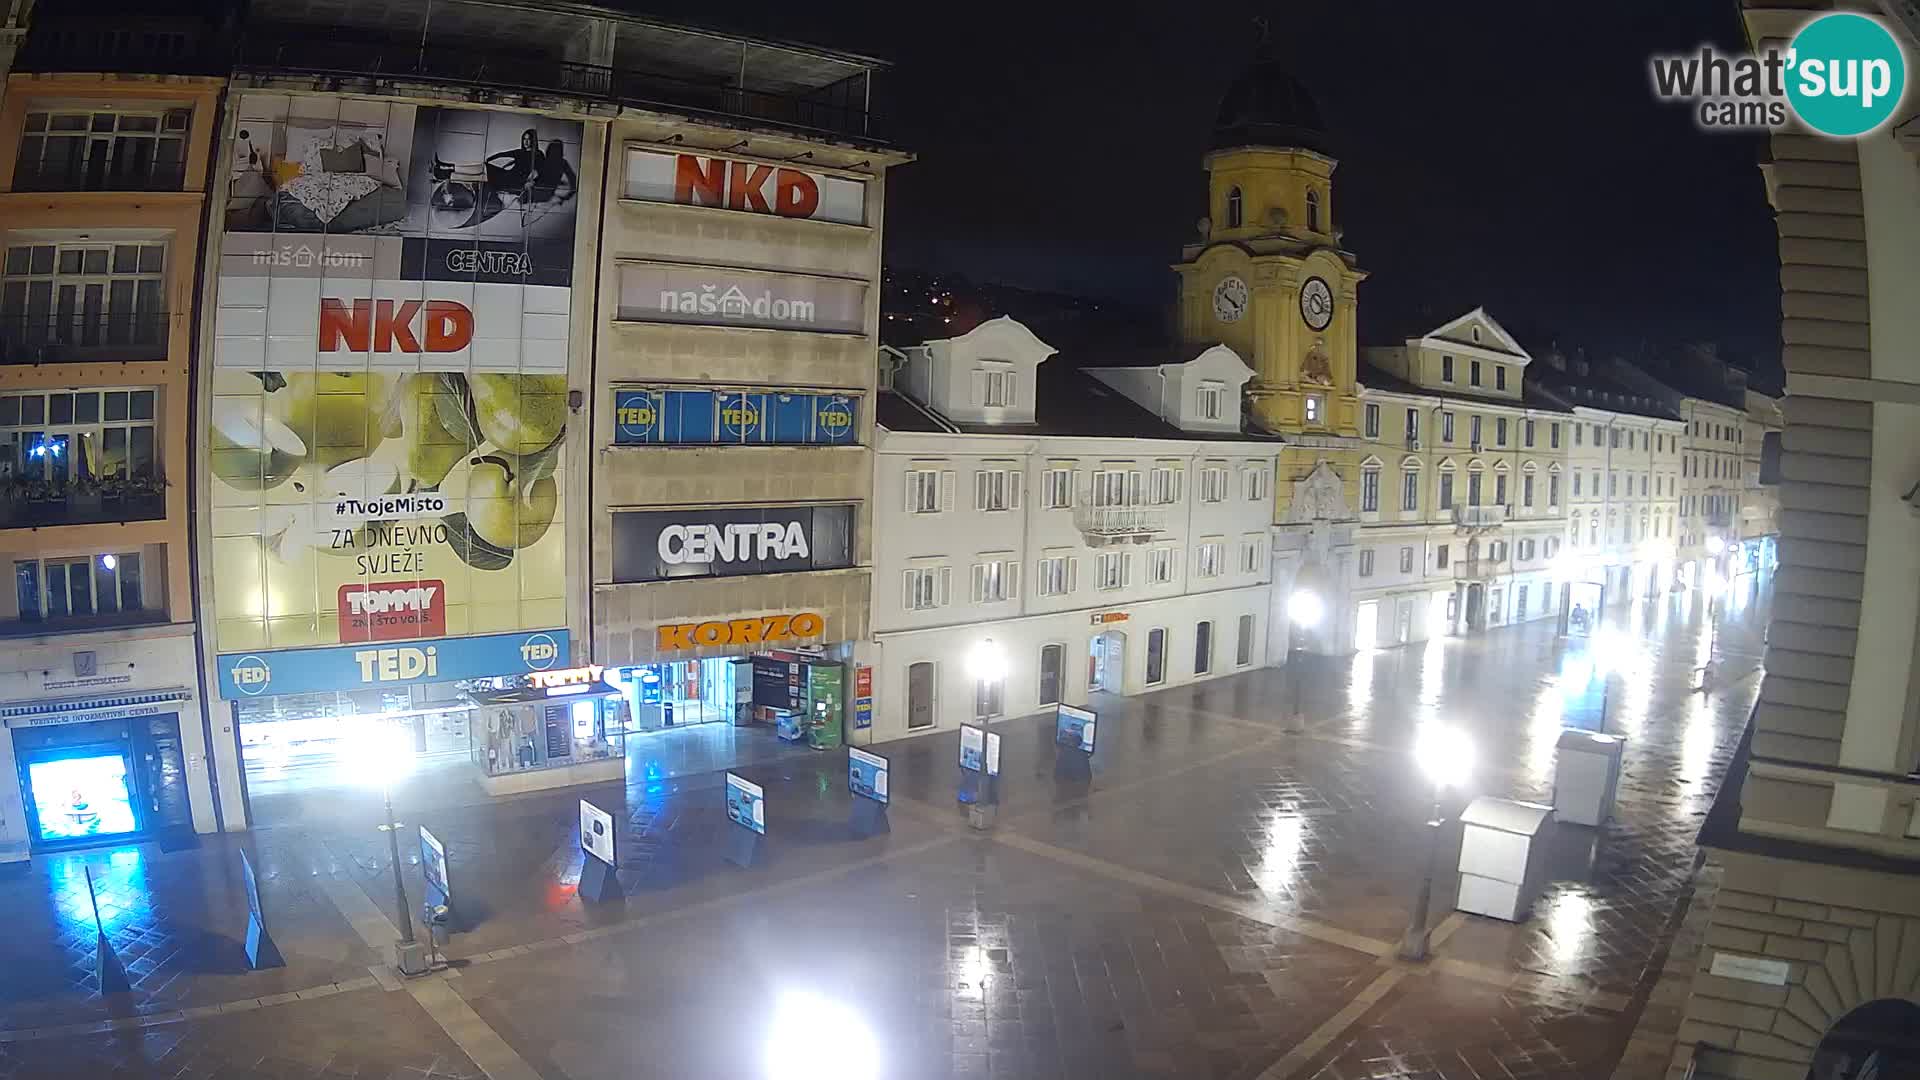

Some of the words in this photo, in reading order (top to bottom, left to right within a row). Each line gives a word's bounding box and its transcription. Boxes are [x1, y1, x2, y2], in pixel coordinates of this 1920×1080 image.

[674, 152, 819, 219] NKD
[317, 249, 364, 268] dom
[446, 249, 533, 275] CENTRA
[660, 284, 716, 315] naš
[752, 290, 816, 322] dom
[318, 297, 475, 353] NKD
[617, 407, 656, 425] TEDi
[722, 408, 759, 425] TEDi
[819, 411, 851, 426] TEDi
[336, 497, 444, 516] #TvojeMisto
[331, 529, 355, 549] ZA
[364, 524, 448, 548] DNEVNO
[657, 521, 809, 564] CENTRA
[357, 548, 424, 575] SVJEŽE
[346, 587, 437, 615] TOMMY
[657, 613, 824, 651] KORZO
[356, 646, 438, 682] TEDi
[520, 644, 558, 661] TEDi
[232, 666, 271, 684] TEDi
[529, 664, 604, 689] TOMMY
